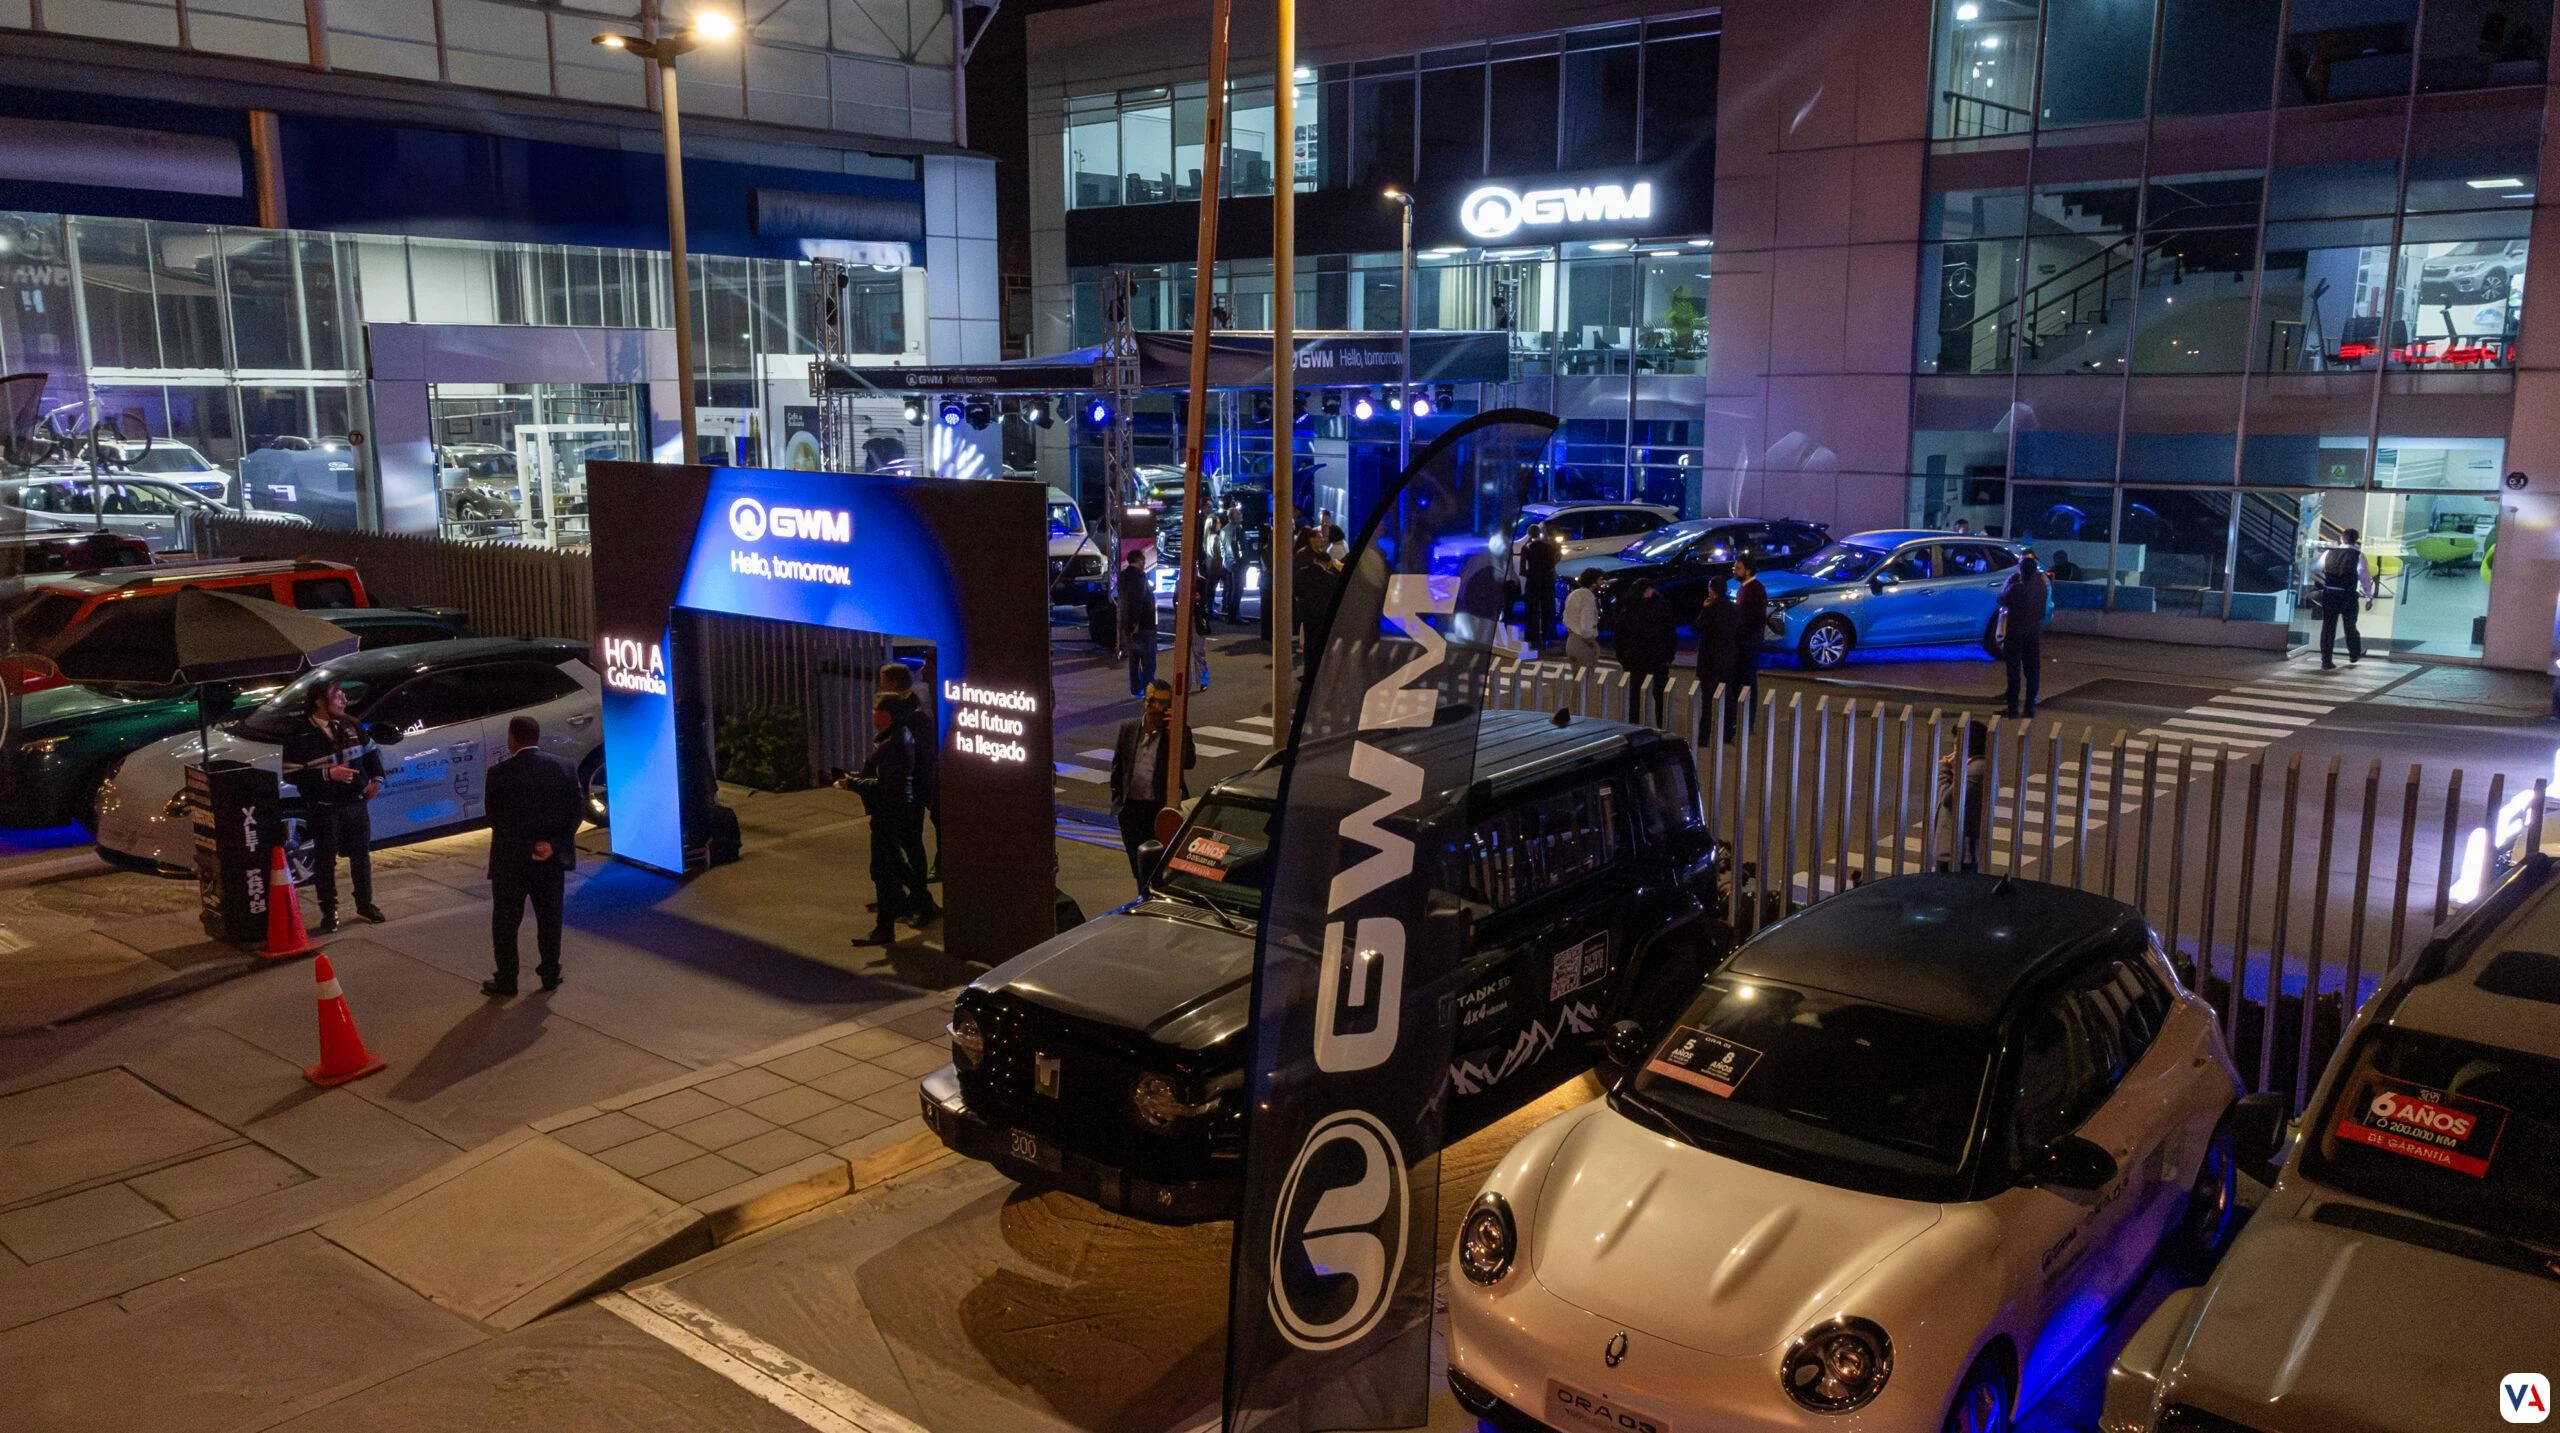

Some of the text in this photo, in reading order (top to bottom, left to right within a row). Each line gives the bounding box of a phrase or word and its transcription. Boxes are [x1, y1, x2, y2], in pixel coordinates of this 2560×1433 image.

[1523, 183, 1651, 224] GWM
[1300, 350, 1334, 368] GWM
[1340, 348, 1363, 367] Hello,
[918, 375, 943, 384] GWM
[769, 507, 850, 542] GWM
[730, 549, 851, 585] Hello, tomorrow.
[604, 636, 665, 677] HOLA
[607, 666, 667, 696] Colombia
[945, 680, 1036, 712] La innovación
[958, 707, 1023, 736] del futuro
[956, 731, 1026, 762] ha llegado
[1313, 574, 1462, 1074] GWM
[1456, 981, 1497, 1008] TANK
[1463, 1003, 1487, 1026] 4x4
[1671, 1048, 1694, 1060] AÑOS
[1684, 1039, 1697, 1051] 5
[1722, 1051, 1735, 1063] 8
[1710, 1060, 1734, 1074] AÑOS
[2370, 1091, 2398, 1117] 6
[2397, 1103, 2470, 1136] AÑOS
[1011, 1133, 1037, 1159] 300
[2367, 1132, 2451, 1164] DE GARANTÍA
[2390, 1121, 2434, 1142] 200.000
[2435, 1135, 2458, 1149] KM
[1557, 1388, 1613, 1423] ORA
